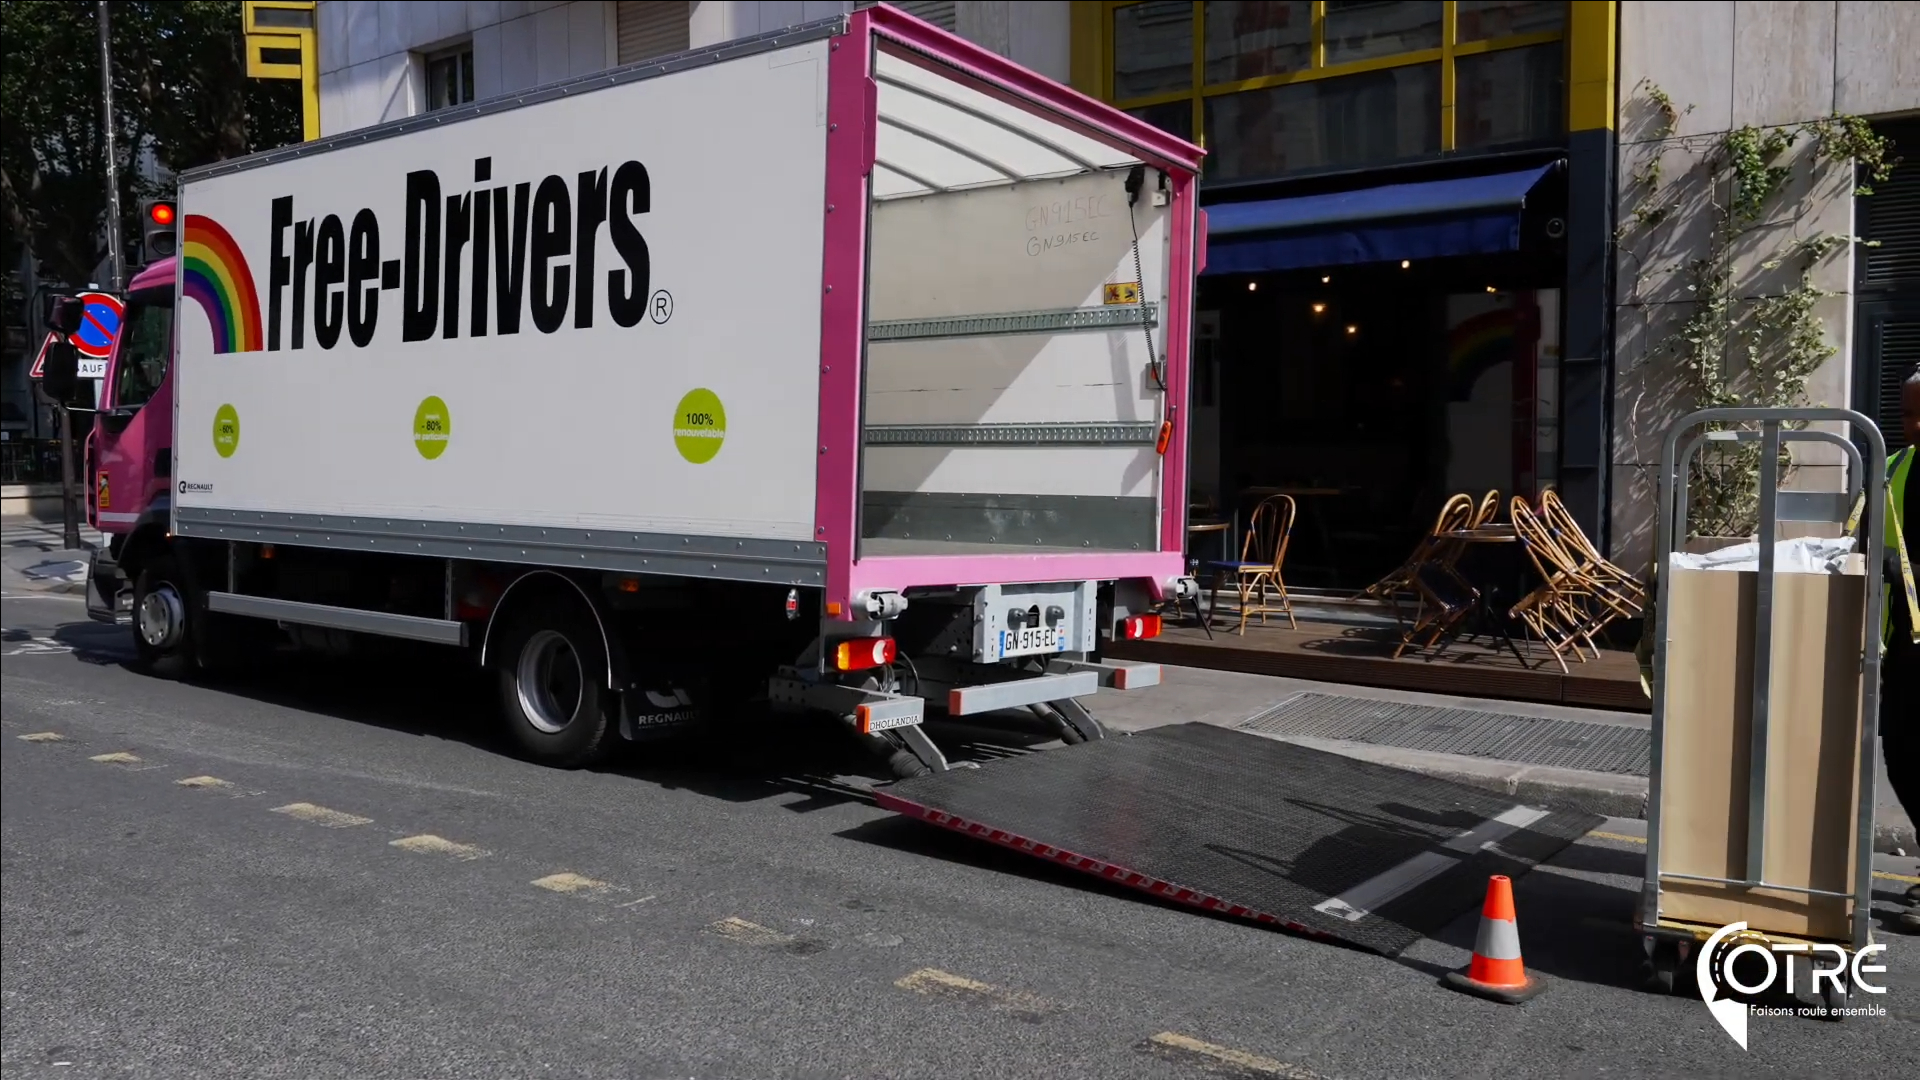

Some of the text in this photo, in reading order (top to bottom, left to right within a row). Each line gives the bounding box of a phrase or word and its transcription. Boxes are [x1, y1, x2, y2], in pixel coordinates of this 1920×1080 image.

[268, 156, 651, 352] Free-Drivers
[686, 412, 714, 426] 100%
[1005, 628, 1057, 651] GN-915-EC
[869, 714, 920, 731] DHOLLANDIA
